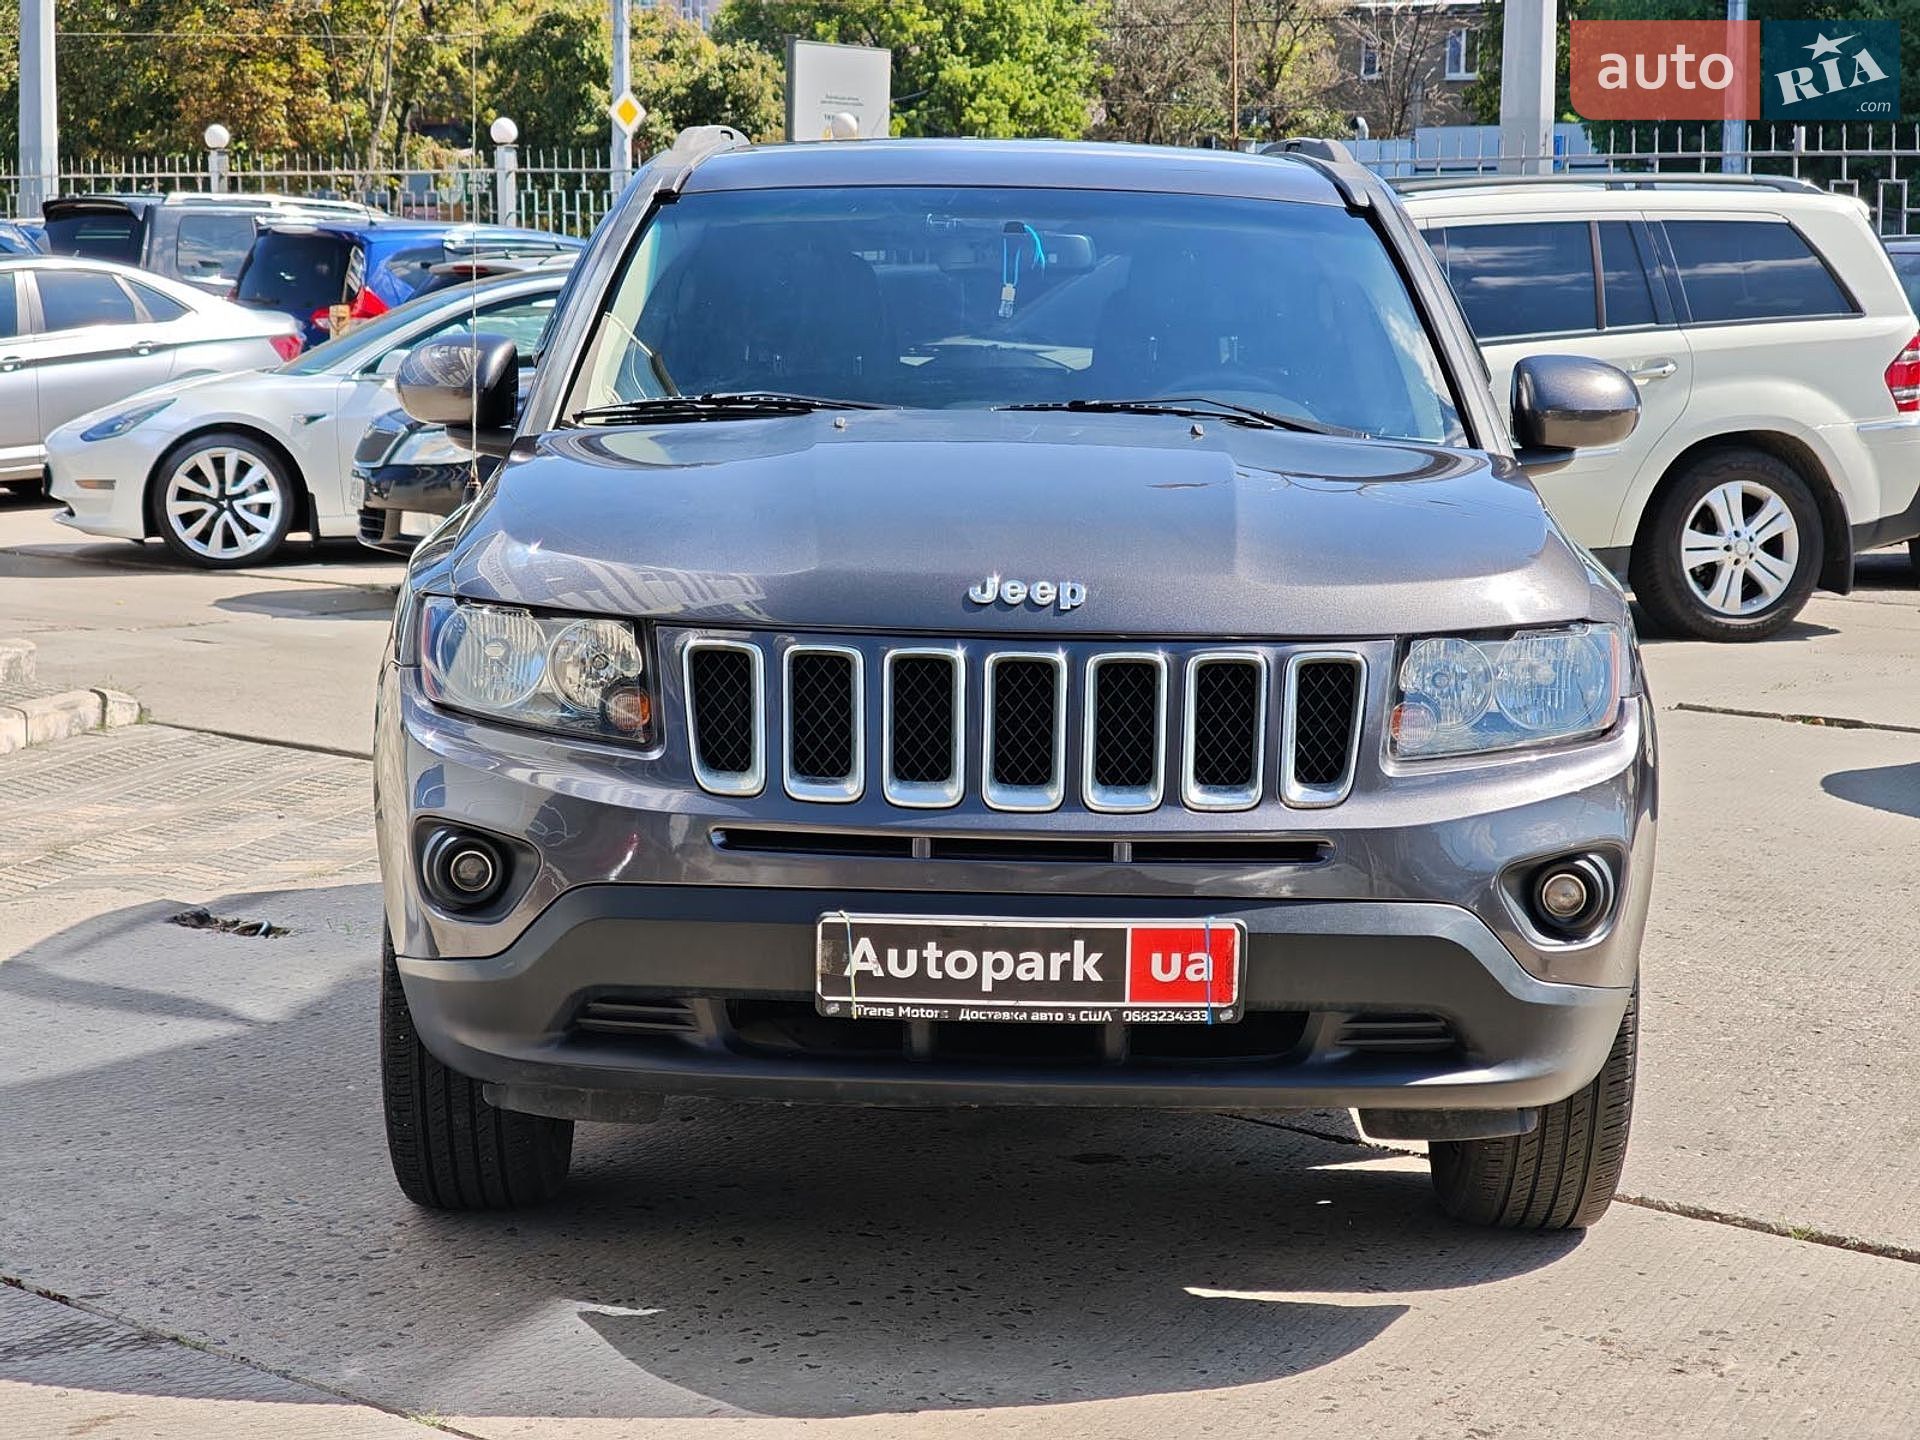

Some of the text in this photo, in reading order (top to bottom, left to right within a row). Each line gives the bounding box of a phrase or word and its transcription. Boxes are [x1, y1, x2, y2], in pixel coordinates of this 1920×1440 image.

[968, 574, 1086, 610] Jeep
[844, 937, 1213, 992] Autopark ua
[855, 1004, 895, 1017] Trans
[1030, 1011, 1064, 1021] авто
[1079, 1010, 1113, 1022] США
